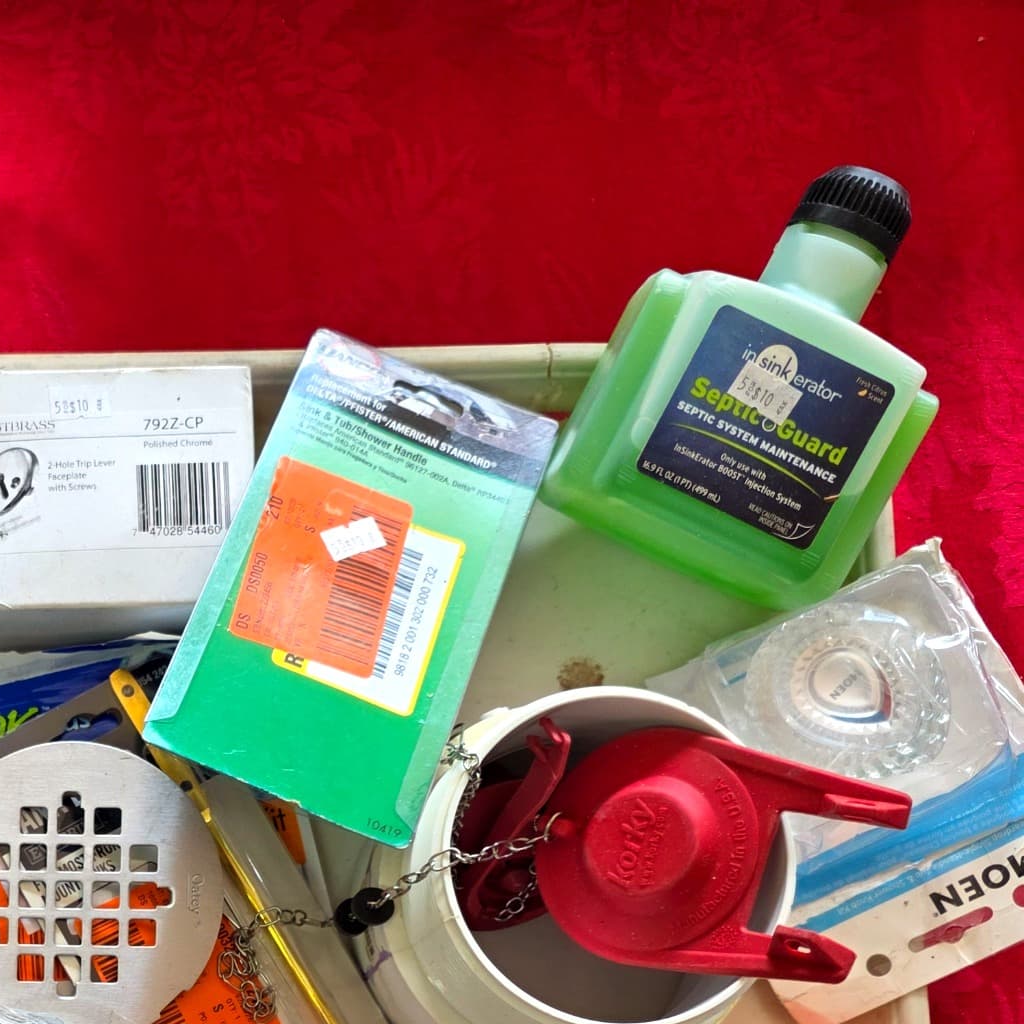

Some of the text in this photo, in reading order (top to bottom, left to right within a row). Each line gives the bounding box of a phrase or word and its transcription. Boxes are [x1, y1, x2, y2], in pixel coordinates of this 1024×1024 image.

[309, 371, 387, 412] Replacement for
[144, 416, 204, 430] 792Z-CP
[690, 376, 848, 466] Septic Guard
[144, 438, 213, 448] Polished Chrome
[322, 411, 333, 422] &
[332, 415, 393, 450] Tub/Shower
[392, 443, 429, 467] Handle
[677, 400, 838, 484] SEPTIC SYSTEM MAINTENANCE
[48, 459, 116, 470] 2-Hole Trip Lever
[48, 472, 87, 482] Faceplate
[672, 442, 718, 471] InSinkErator
[742, 476, 776, 500] Injection
[774, 491, 802, 513] System
[718, 451, 767, 481] Only use with
[48, 483, 96, 492] with Screws
[132, 525, 222, 536] 7 47028 54460
[393, 565, 438, 677] 9818 2 001 302 000 732
[829, 672, 863, 702] MOEN
[607, 797, 657, 889] korky
[928, 850, 1024, 917] MOEN
